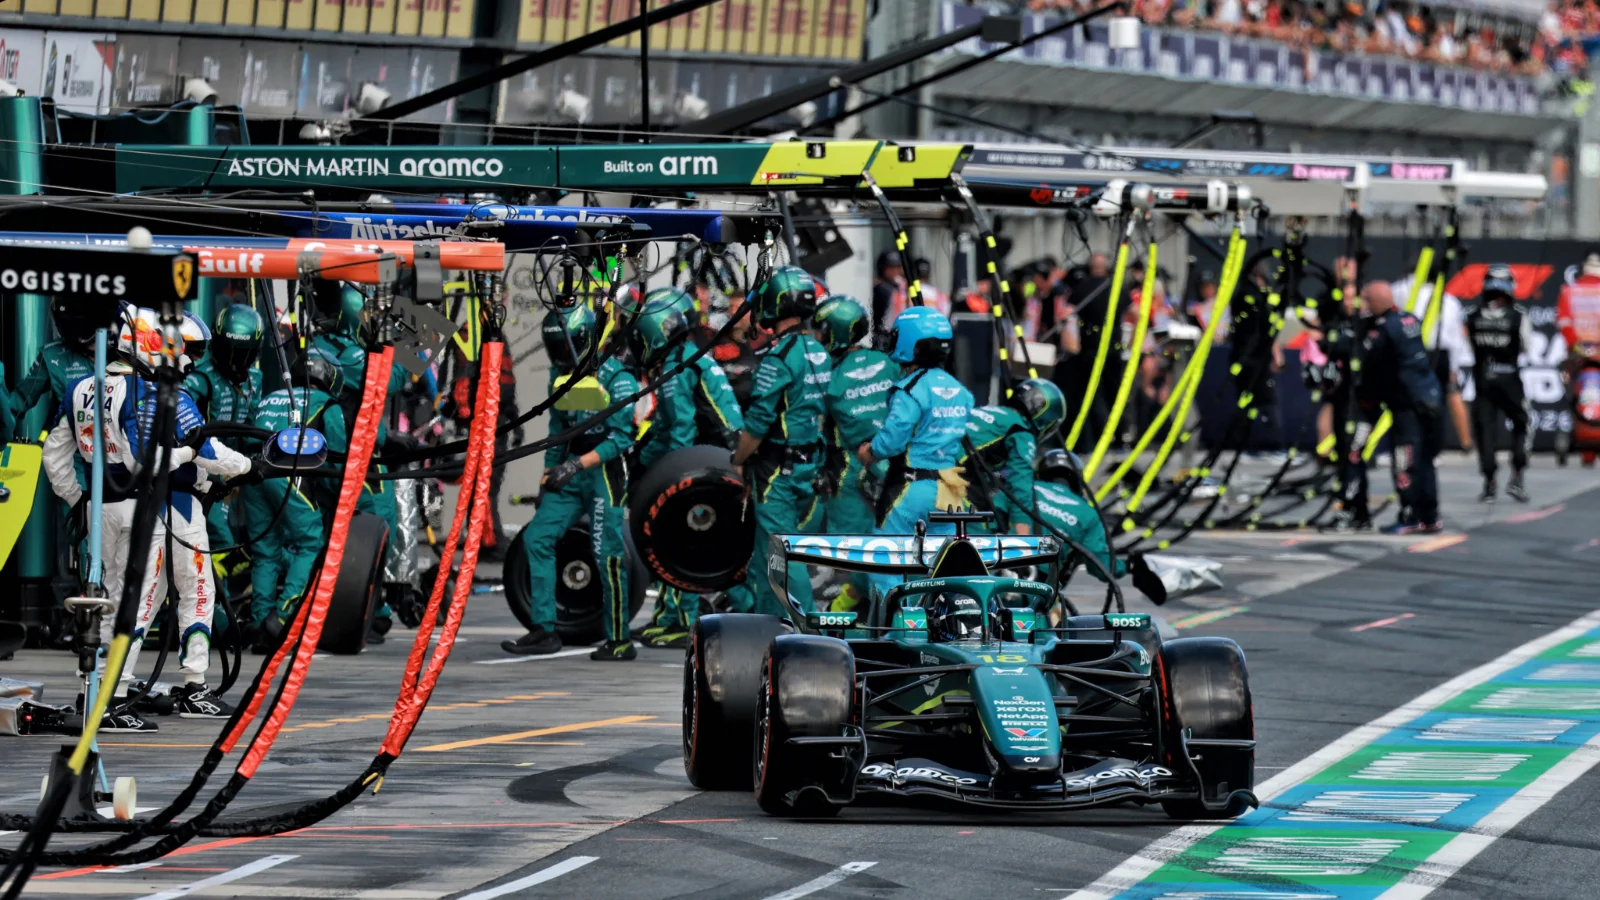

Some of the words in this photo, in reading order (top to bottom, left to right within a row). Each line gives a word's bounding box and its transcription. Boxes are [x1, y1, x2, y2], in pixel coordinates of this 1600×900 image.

[228, 158, 299, 176] ASTON
[306, 158, 389, 176] MARTIN
[399, 158, 503, 177] aramco
[604, 161, 634, 173] Built
[636, 162, 653, 173] on
[659, 155, 718, 176] arm
[199, 251, 265, 273] Gulf
[593, 497, 604, 554] MARTIN
[1020, 582, 1048, 591] BREITLING
[820, 616, 851, 626] BOSS
[1112, 617, 1141, 627] BOSS
[977, 655, 1027, 663] 18
[861, 765, 977, 785] aramco
[1066, 767, 1173, 786] aramco
